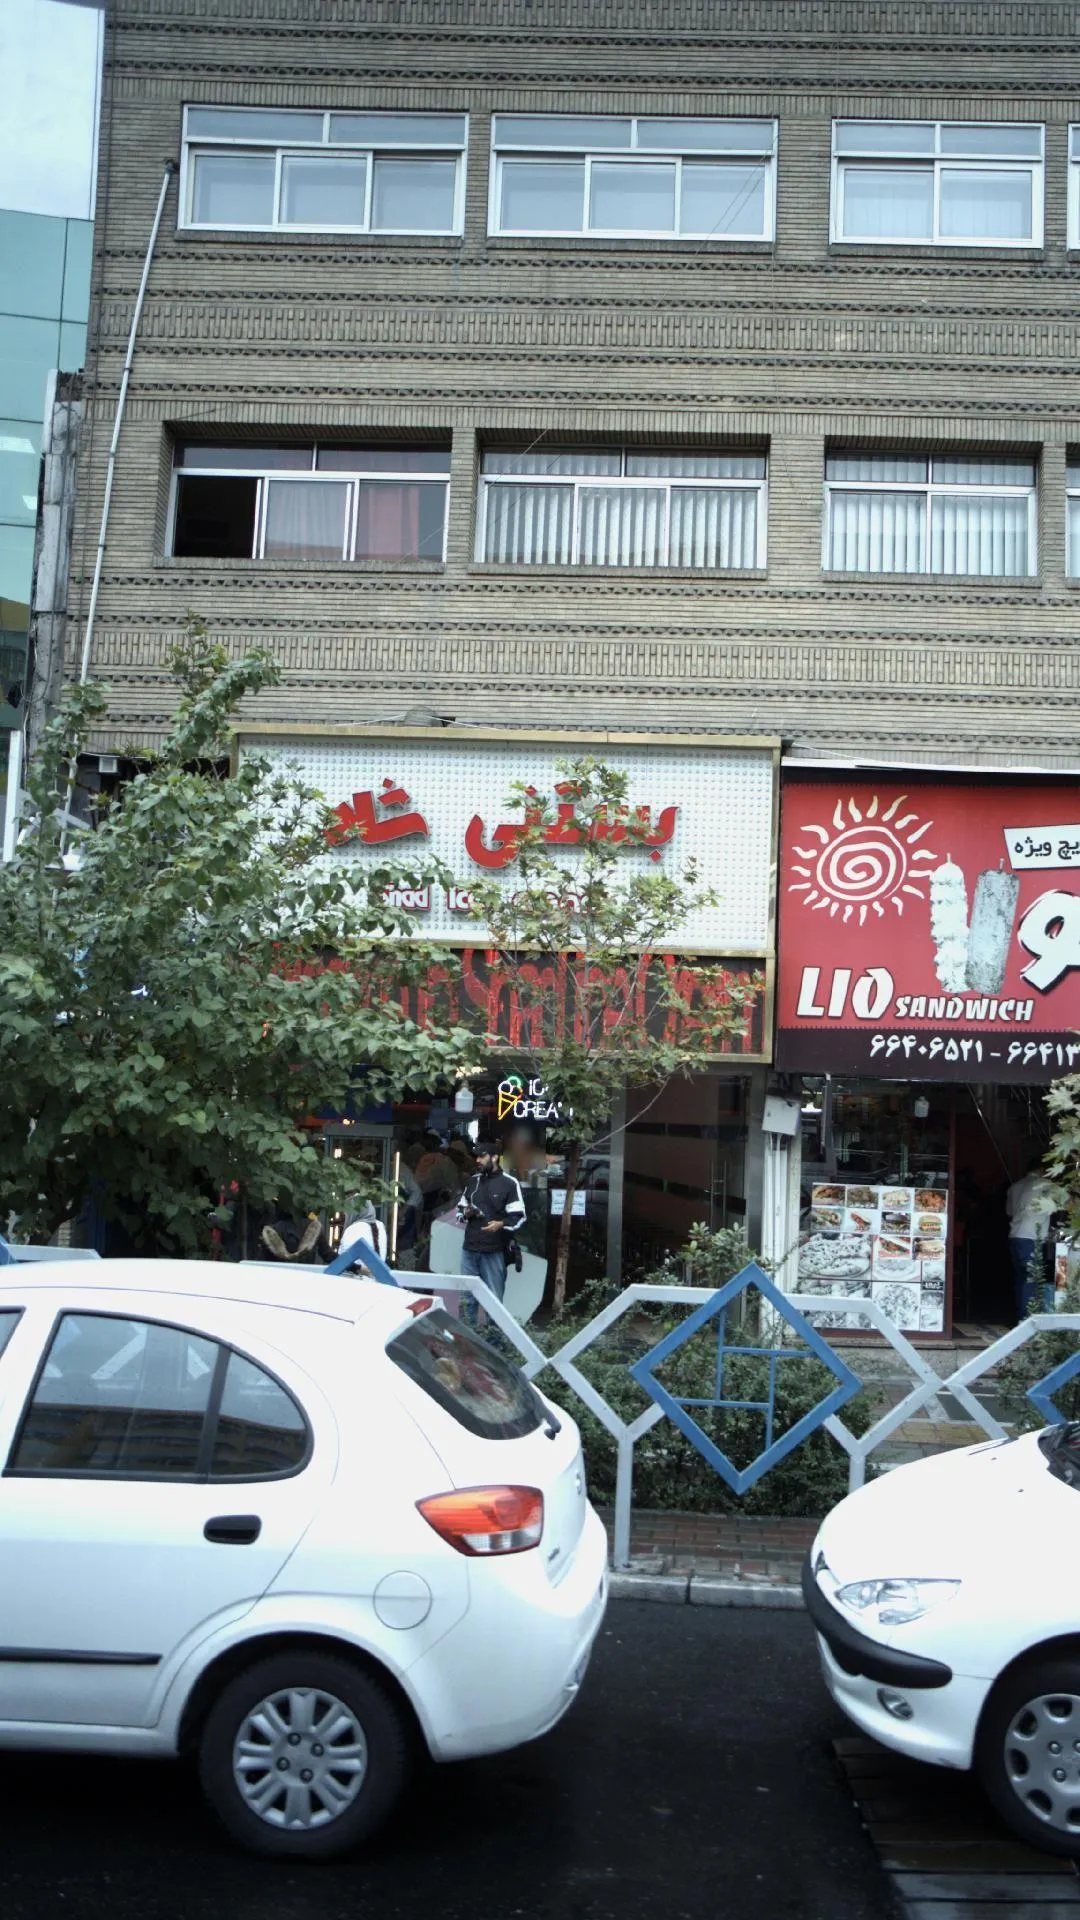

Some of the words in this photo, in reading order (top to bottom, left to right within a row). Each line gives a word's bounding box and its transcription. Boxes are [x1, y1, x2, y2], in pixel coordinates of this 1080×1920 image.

[464, 780, 679, 869] بستنی
[1014, 836, 1053, 858] ویژه
[797, 967, 894, 1019] LIO
[895, 995, 1035, 1022] SANDWICH
[869, 1034, 984, 1064] ۶۶۴۰۶۵۲۱
